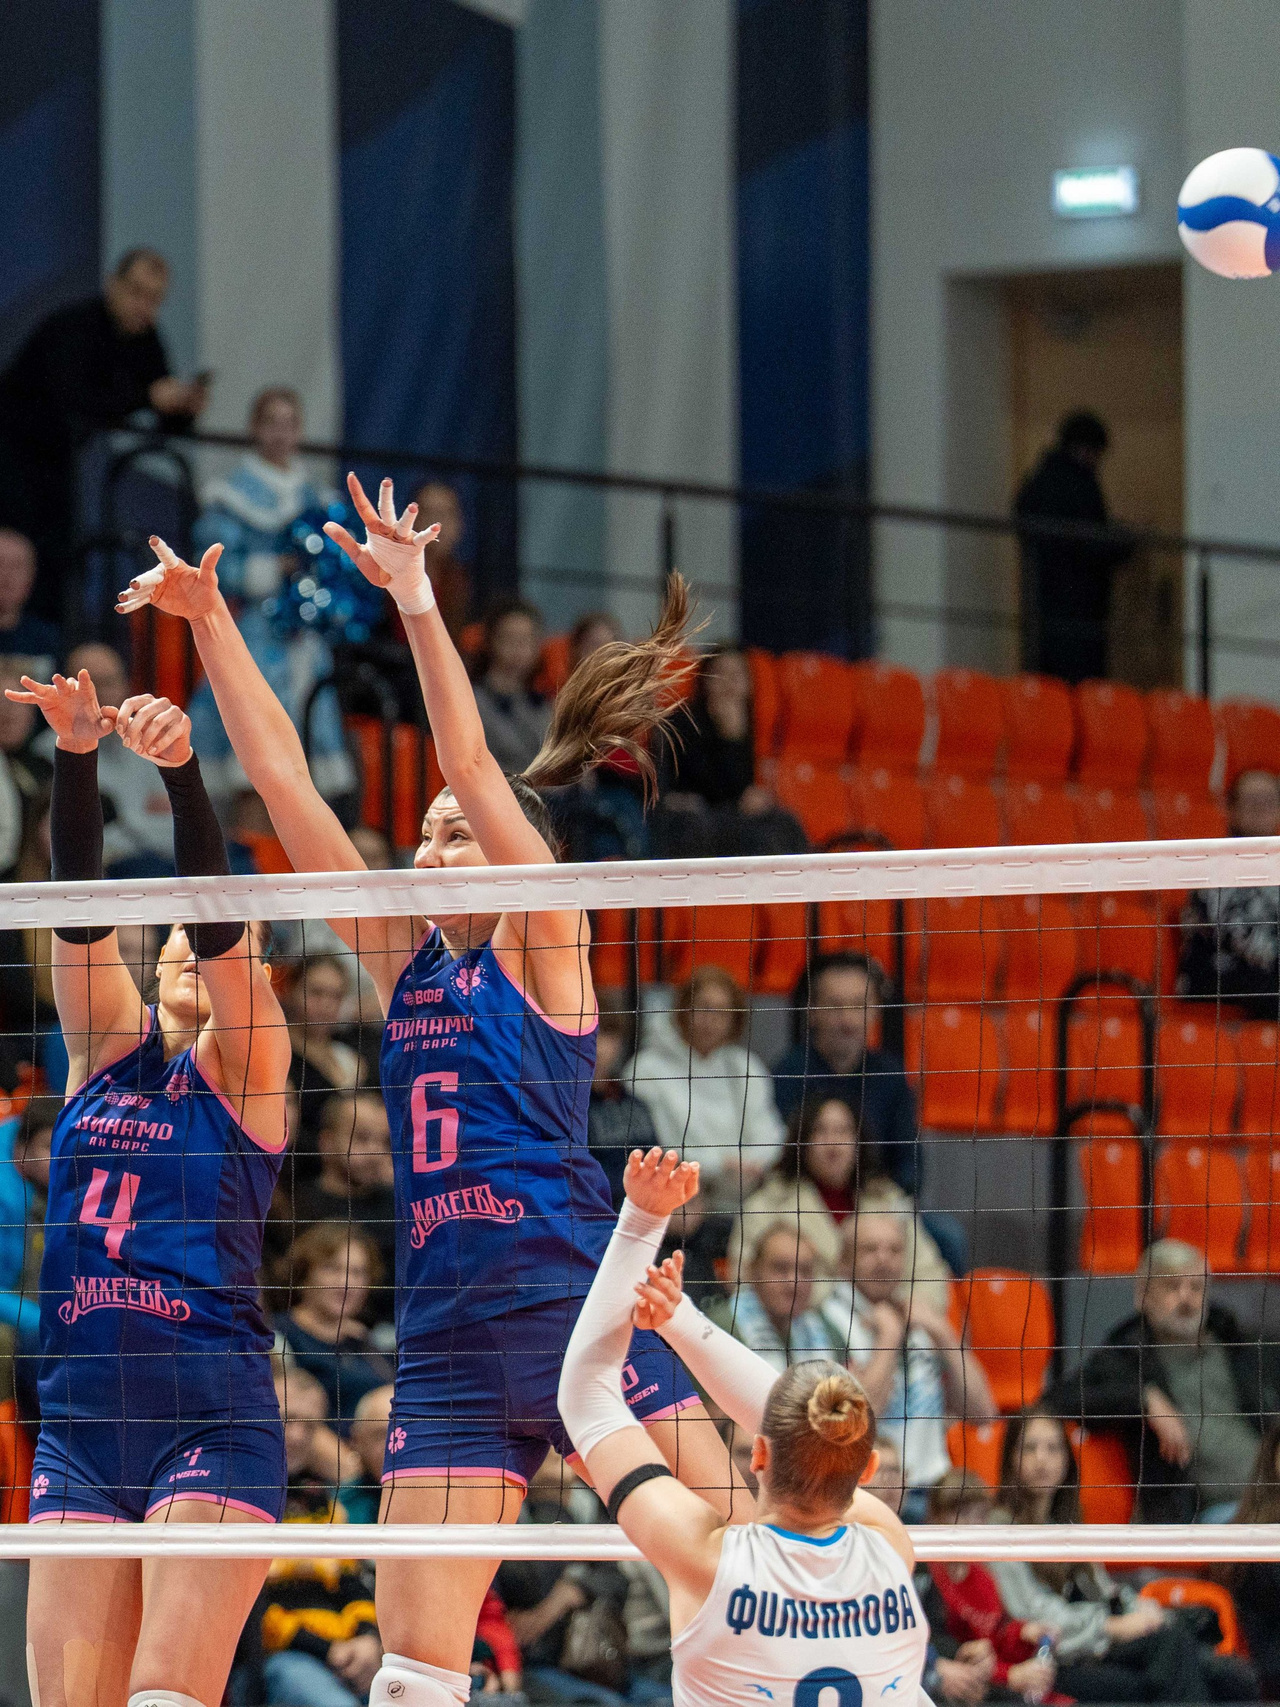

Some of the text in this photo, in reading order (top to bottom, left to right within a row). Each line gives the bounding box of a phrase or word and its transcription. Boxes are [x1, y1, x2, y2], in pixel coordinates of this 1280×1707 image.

[415, 988, 445, 1005] ВФВ
[422, 1037, 458, 1050] БАРС
[75, 1115, 174, 1141] ДИНАМО
[410, 1071, 459, 1173] 6
[111, 1139, 150, 1152] БАРС
[78, 1167, 141, 1260] 4
[625, 1382, 659, 1406] NSEN
[725, 1583, 917, 1639] ФИЛИППОВА
